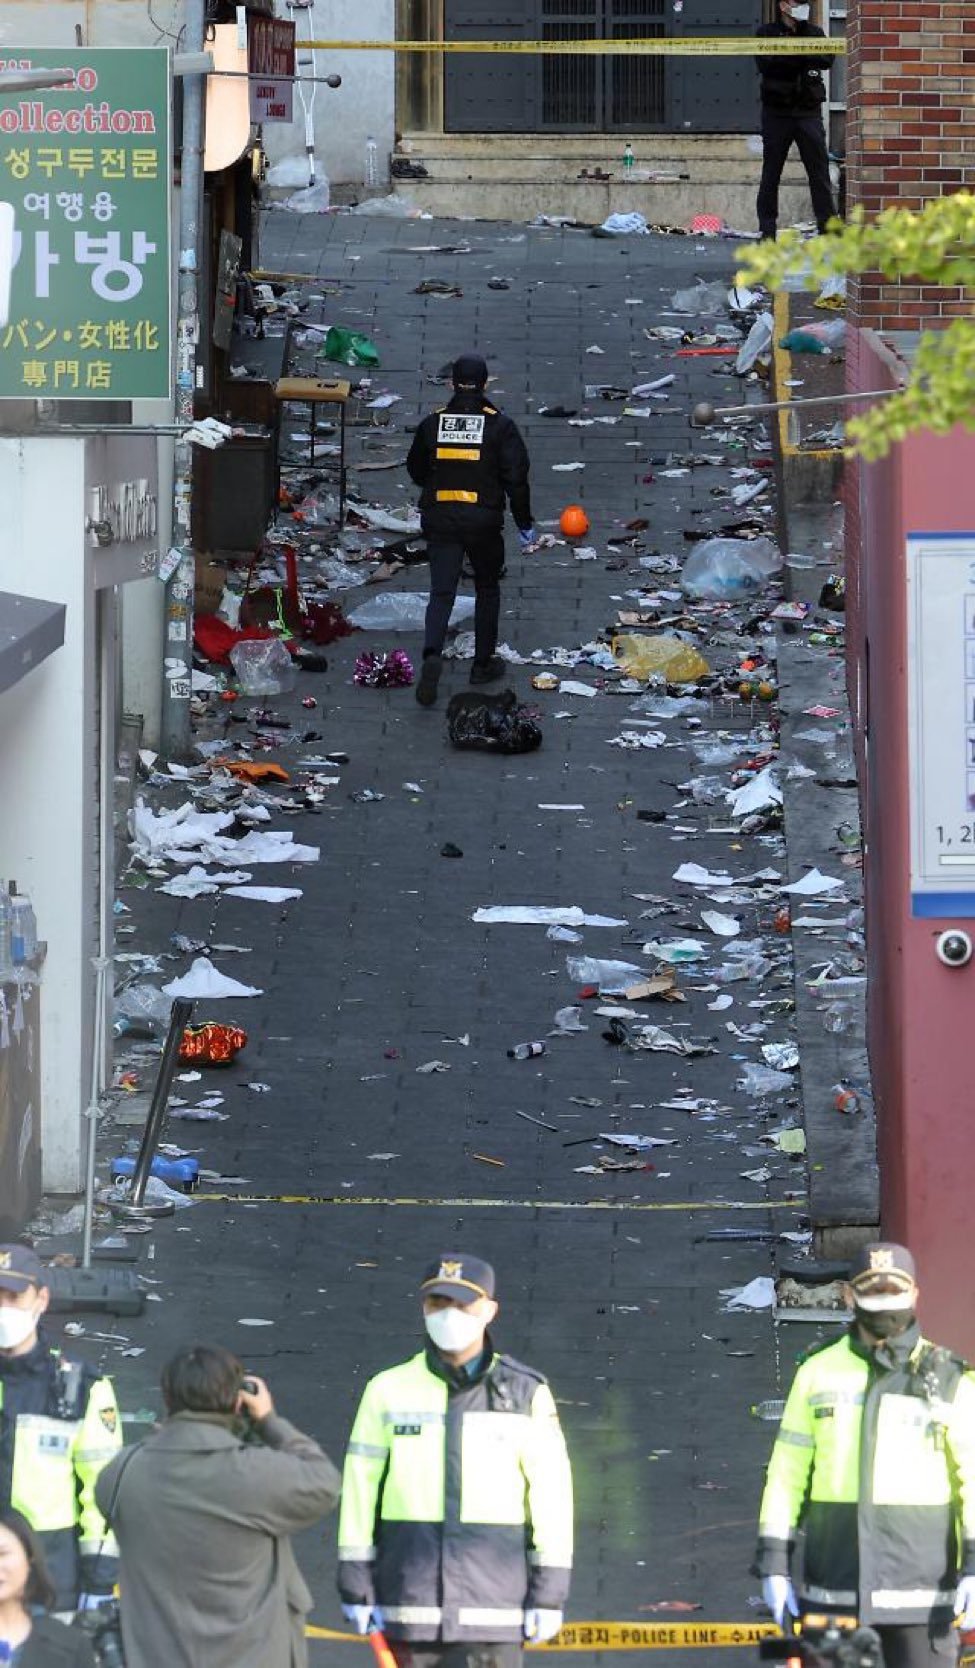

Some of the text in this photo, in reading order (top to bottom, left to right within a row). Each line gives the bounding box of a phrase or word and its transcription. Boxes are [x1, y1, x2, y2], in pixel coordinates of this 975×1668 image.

[5, 148, 158, 179] 성구두전문
[23, 191, 118, 222] 여행용
[11, 231, 156, 302] 가방
[442, 432, 478, 441] POLICE
[960, 822, 975, 843] 2
